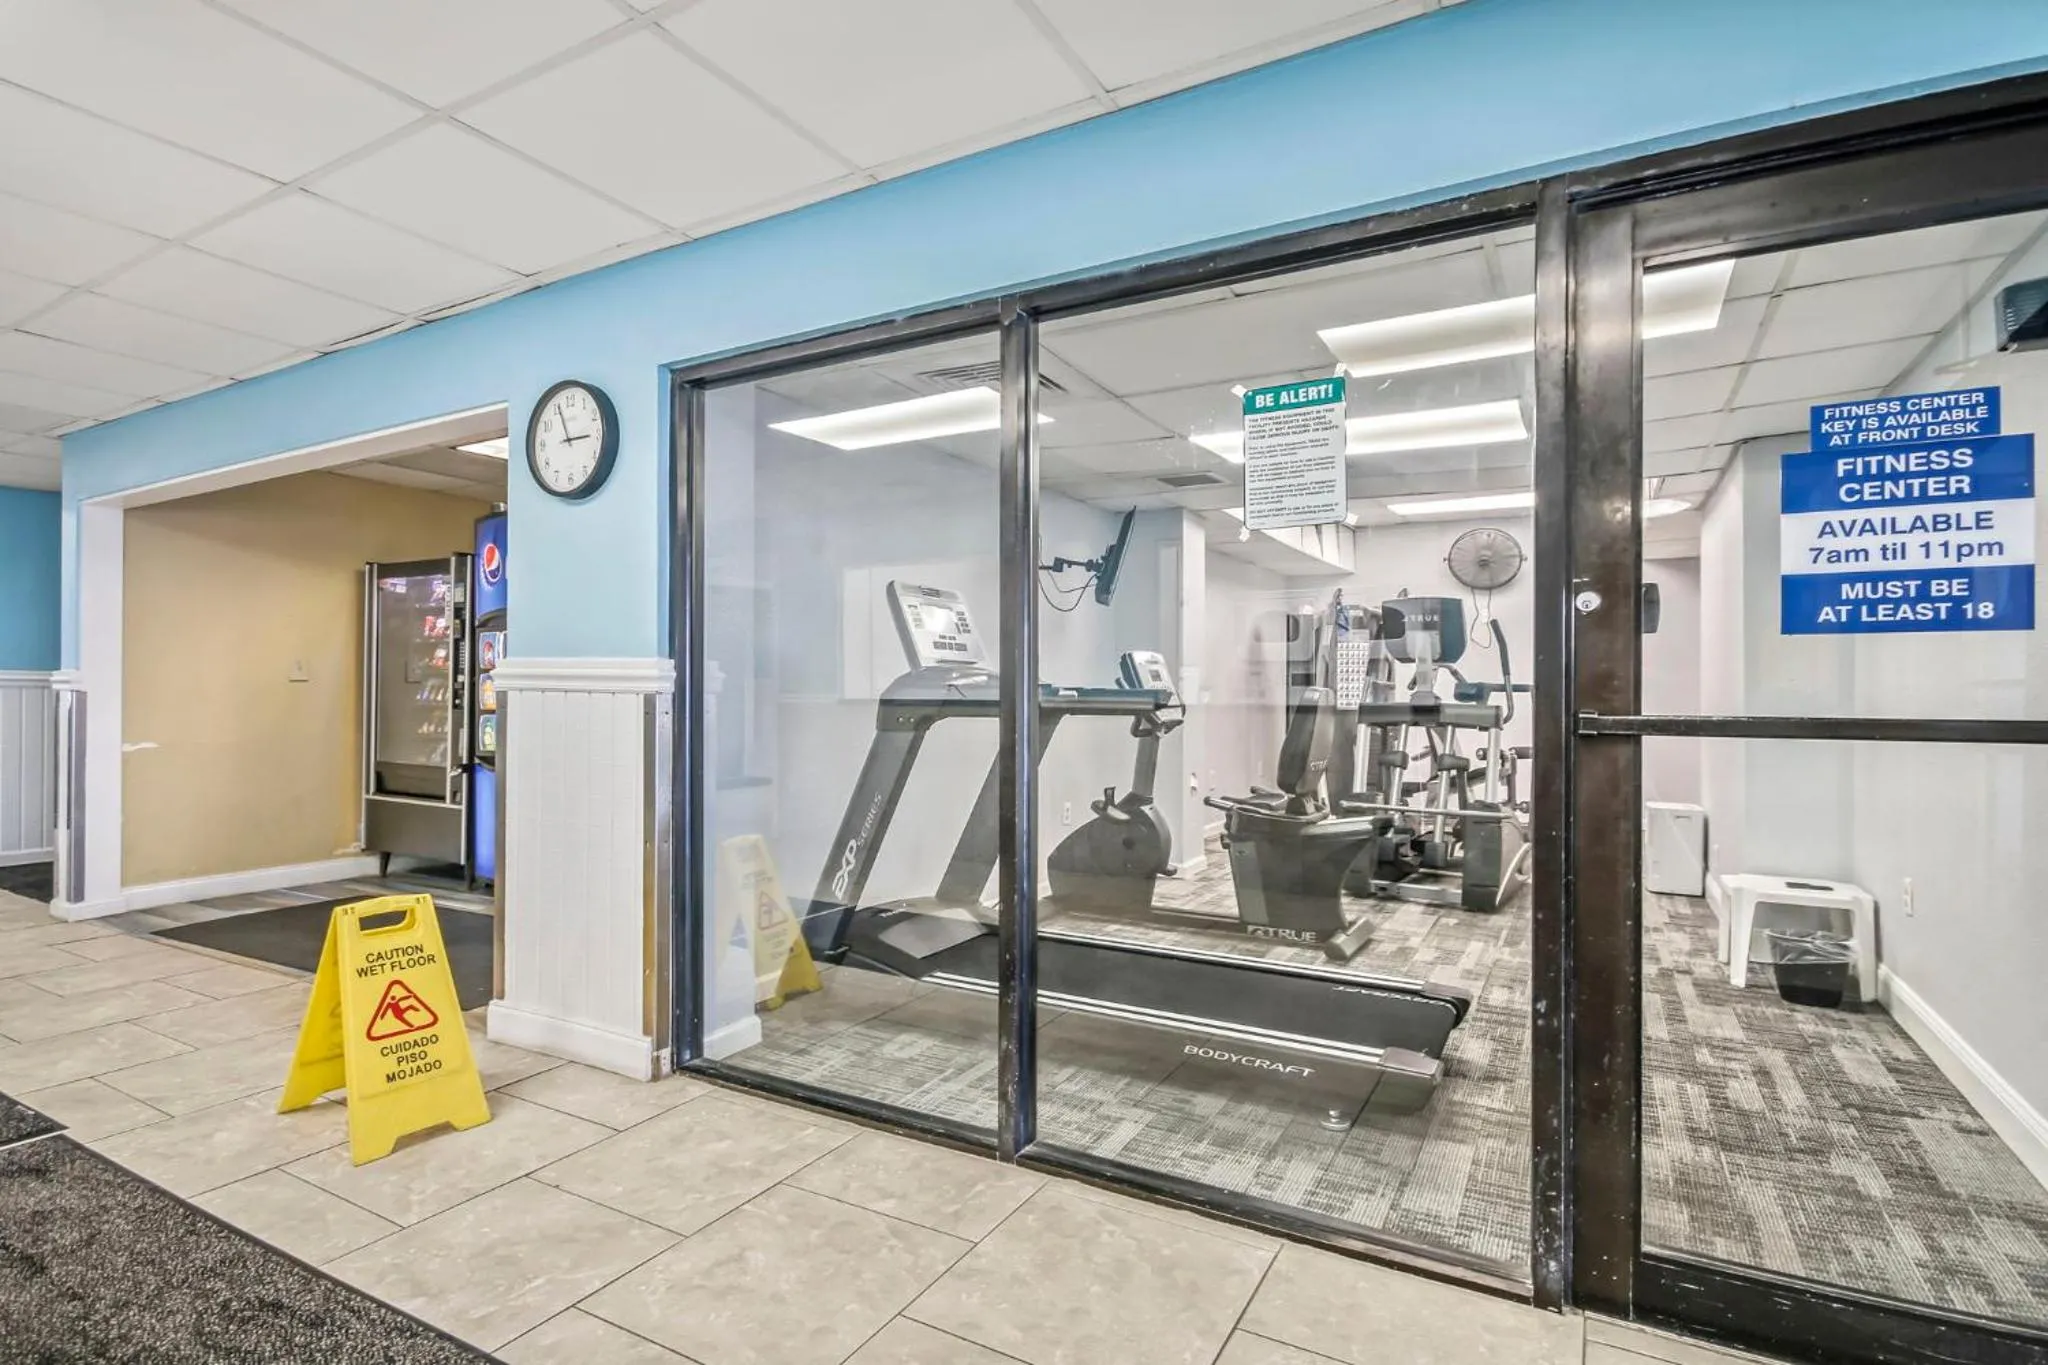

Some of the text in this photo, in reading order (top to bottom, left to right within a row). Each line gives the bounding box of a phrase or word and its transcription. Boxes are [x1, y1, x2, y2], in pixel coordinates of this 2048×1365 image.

[1255, 384, 1333, 408] BE ALERT!
[1824, 392, 1985, 419] FITNESS CENTER
[1821, 406, 1989, 434] KEY IS AVAILABLE
[1829, 421, 1980, 447] AT FRONT DESK
[1836, 447, 1974, 477] FITNESS
[1839, 475, 1971, 503] CENTER
[1817, 510, 1995, 539] AVAILABLE
[1809, 540, 2005, 564] 7am til 11pm
[1841, 578, 1970, 600] MUST BE
[1816, 601, 1996, 623] AT LEAST 18
[1265, 926, 1318, 944] TRUE
[356, 954, 437, 978] WET FLOOR
[365, 944, 424, 964] CAUTION
[380, 1034, 440, 1058] CUIDADO
[396, 1050, 428, 1067] PISO
[1183, 1044, 1317, 1077] BODYCRAFT
[386, 1060, 443, 1084] MOJADO
